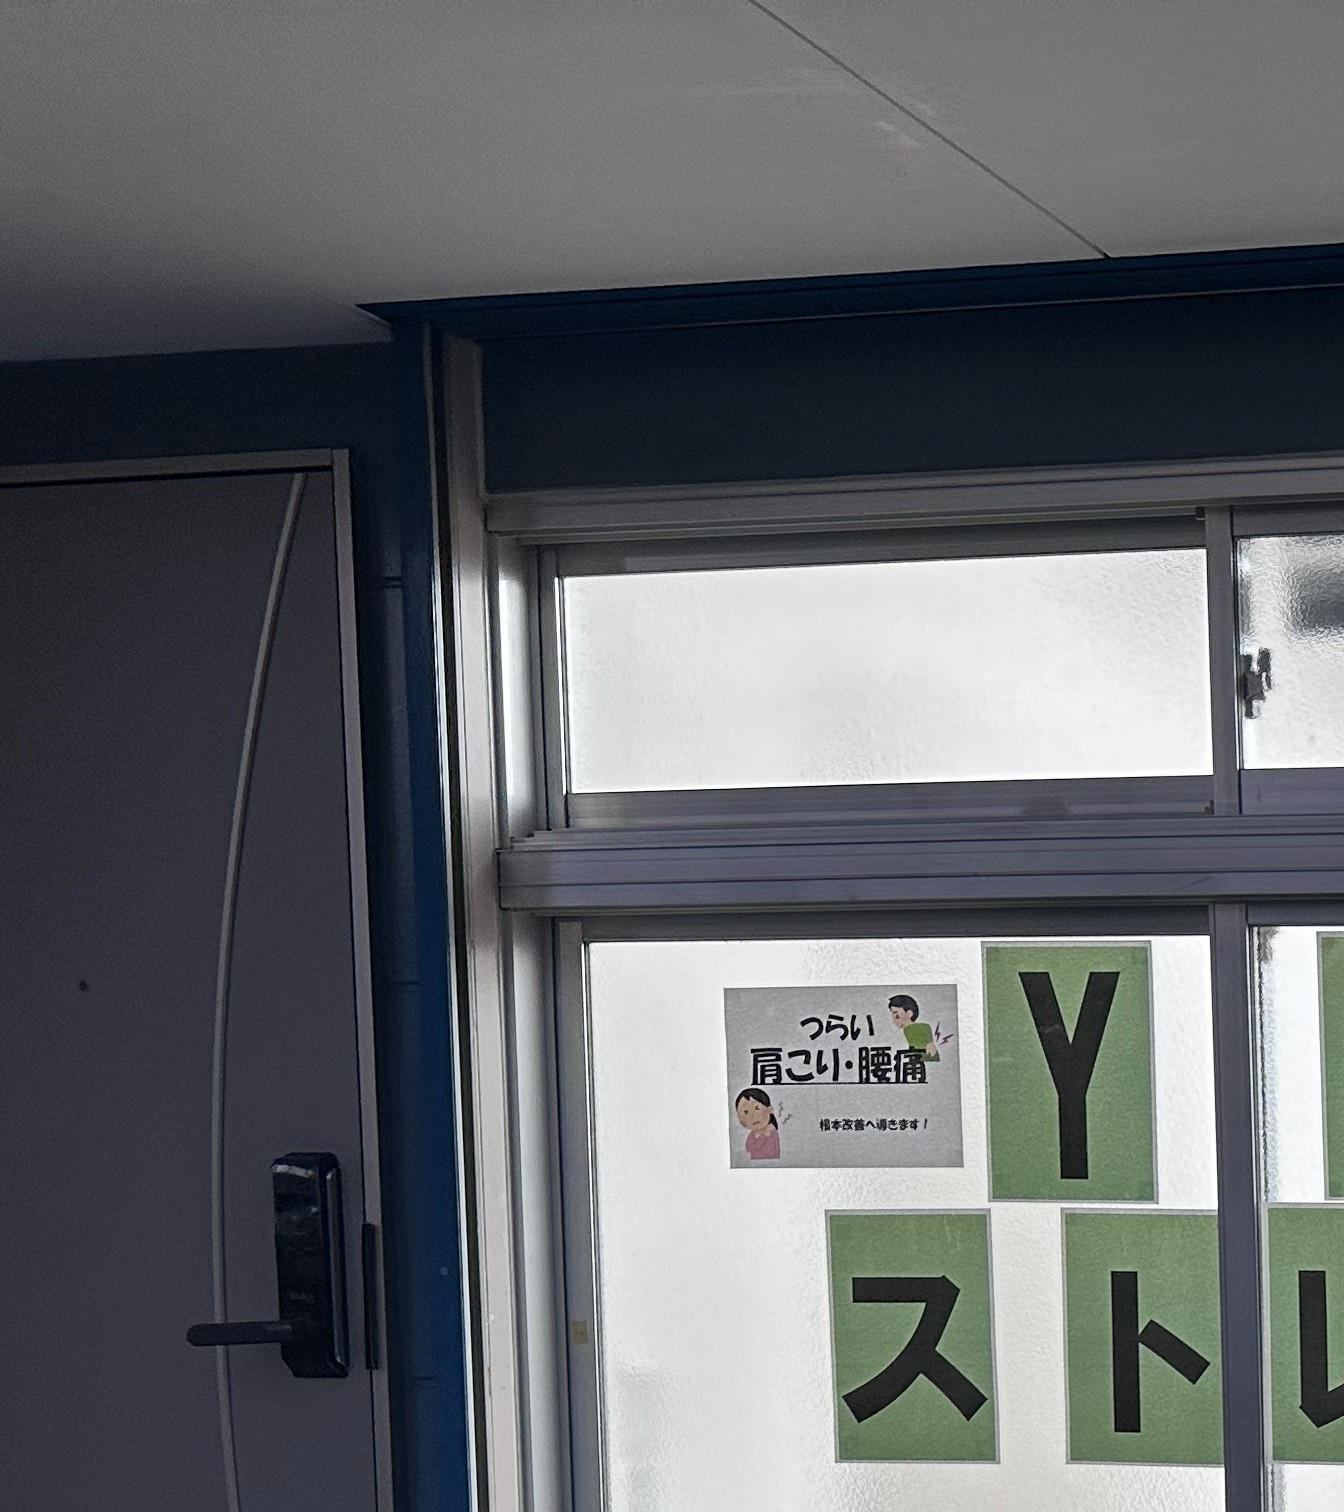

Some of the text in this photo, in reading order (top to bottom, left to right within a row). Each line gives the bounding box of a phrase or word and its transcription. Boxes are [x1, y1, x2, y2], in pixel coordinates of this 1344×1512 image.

[800, 1014, 875, 1040] つらい
[750, 1046, 927, 1085] 肩こり・腰痛
